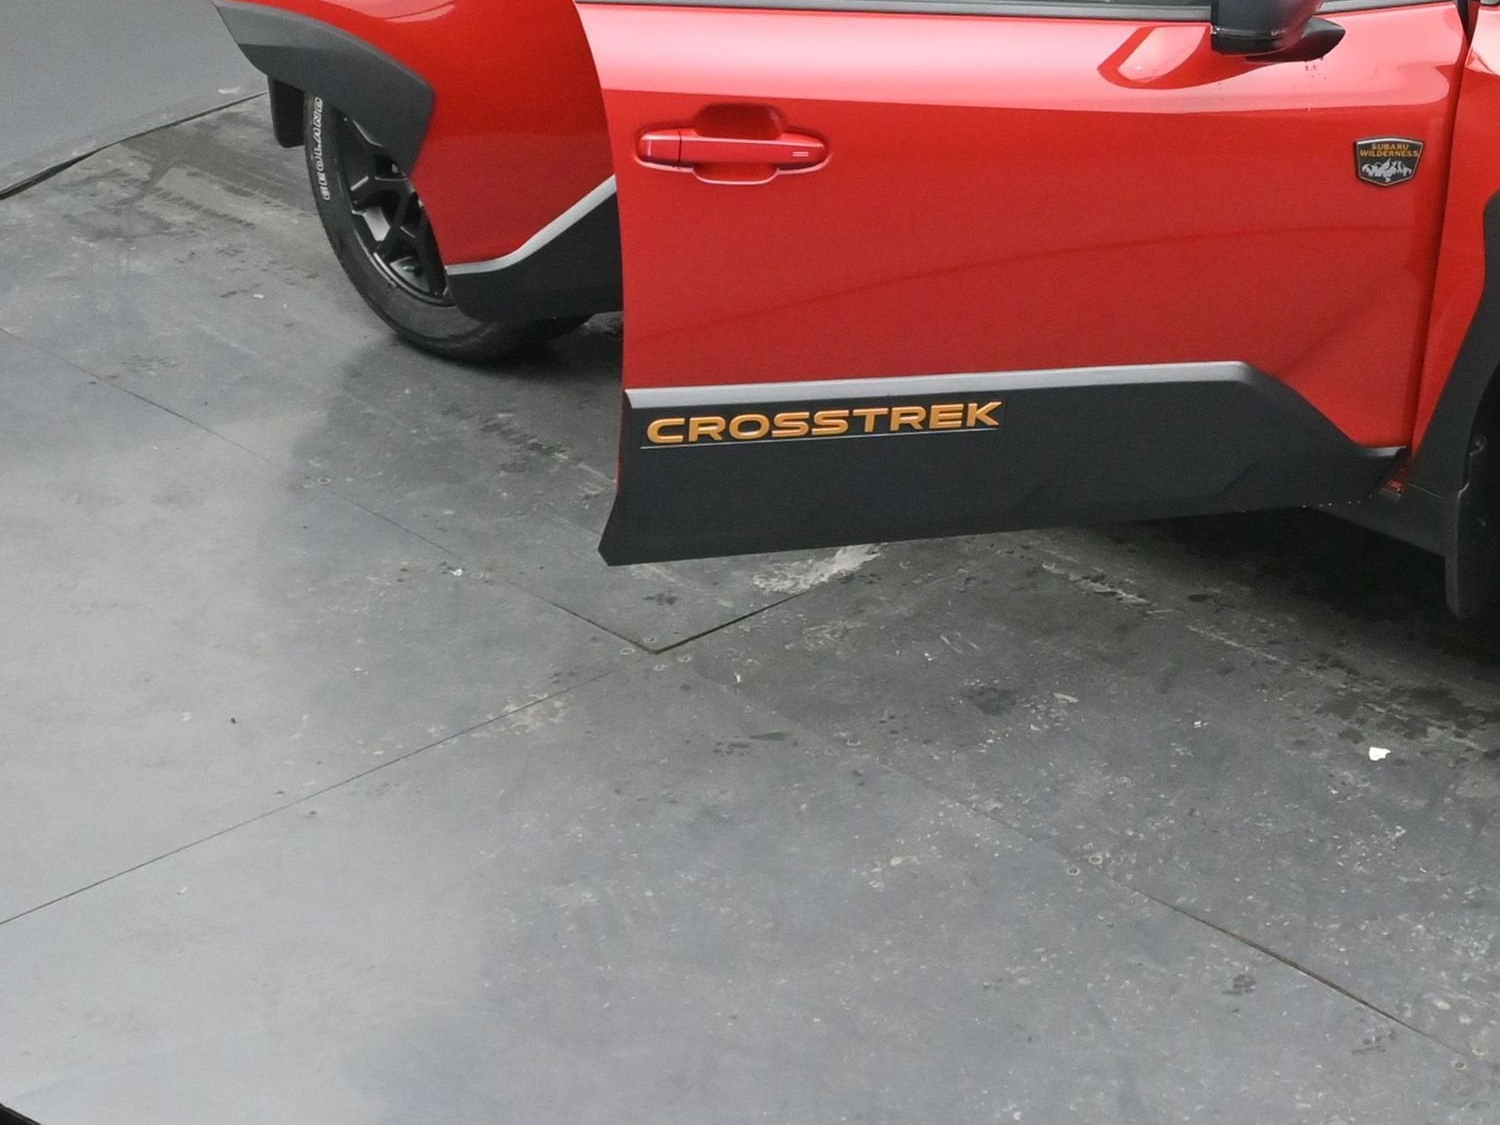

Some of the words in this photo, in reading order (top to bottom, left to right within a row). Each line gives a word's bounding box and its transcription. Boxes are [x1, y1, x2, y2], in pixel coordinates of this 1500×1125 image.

[313, 96, 331, 201] GEOLAND
[1360, 149, 1419, 157] WILDERNESS
[646, 401, 1003, 444] CROSSTREK
